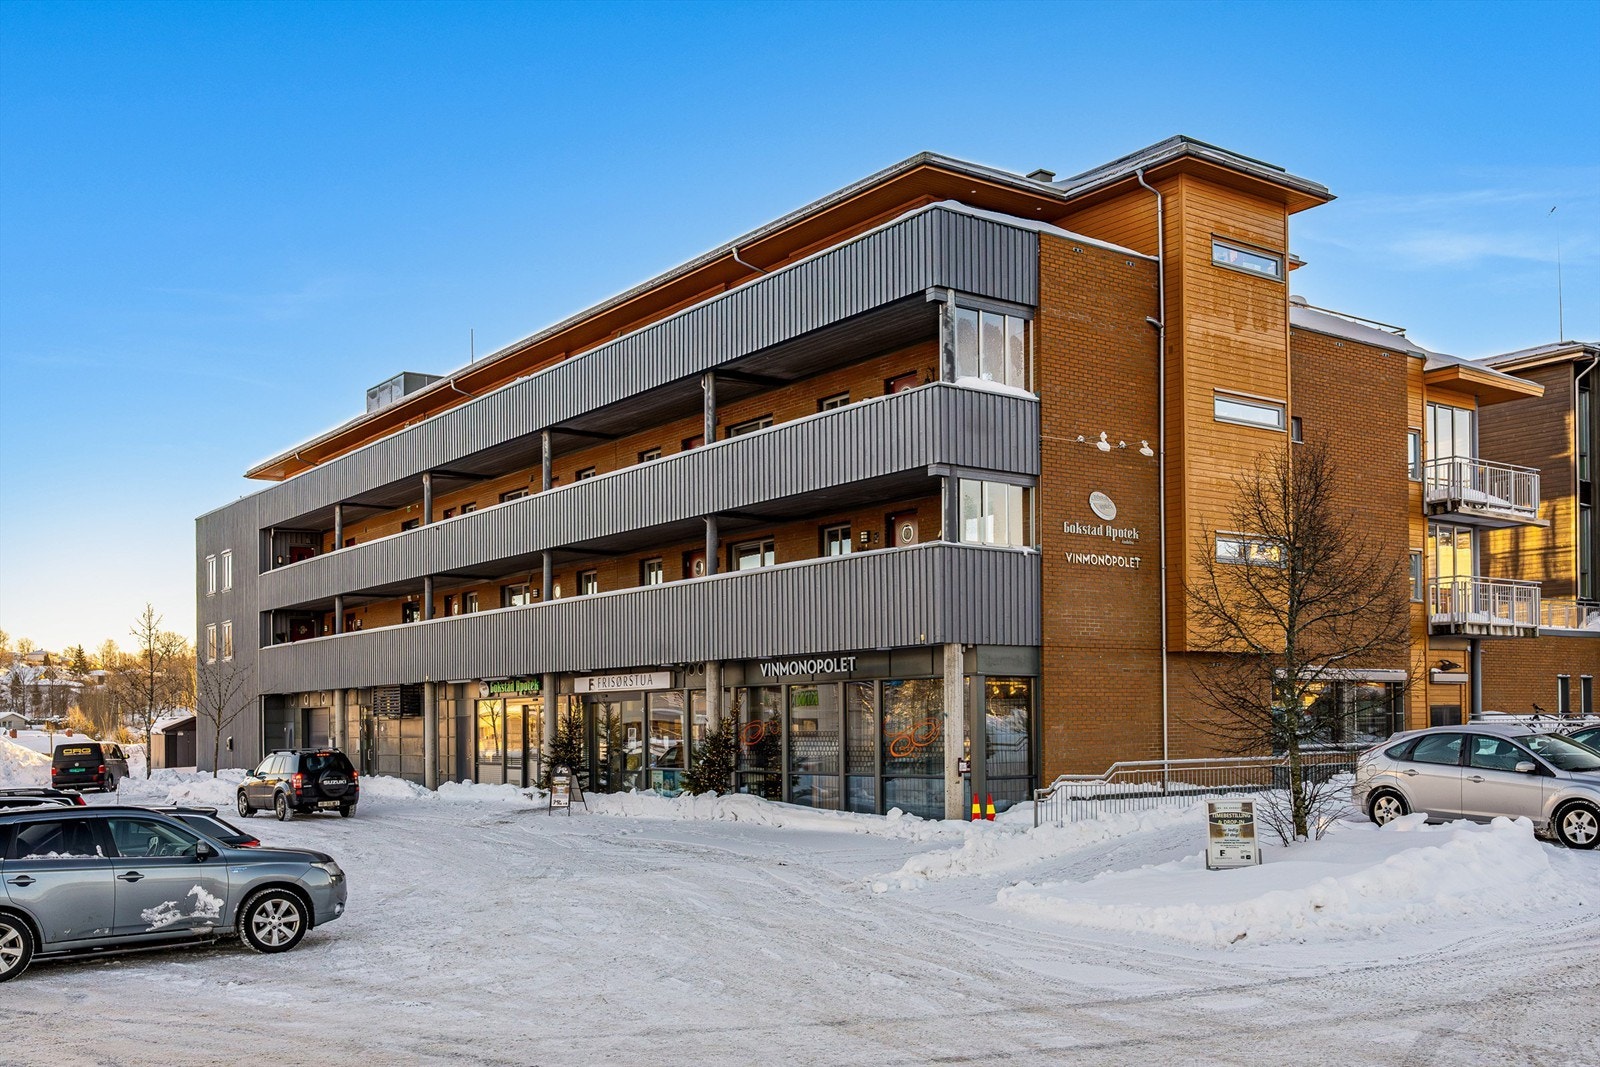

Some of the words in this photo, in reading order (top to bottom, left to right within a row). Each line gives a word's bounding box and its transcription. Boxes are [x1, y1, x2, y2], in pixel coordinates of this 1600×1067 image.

[1063, 521, 1103, 536] Gokstad
[1105, 525, 1139, 541] Apotek
[1065, 552, 1141, 568] VINMONOPOLET
[760, 656, 856, 677] VINMONOPOLET
[490, 681, 514, 693] Gokstad
[515, 679, 539, 695] Apotek
[597, 674, 653, 688] FRISØRSTUA
